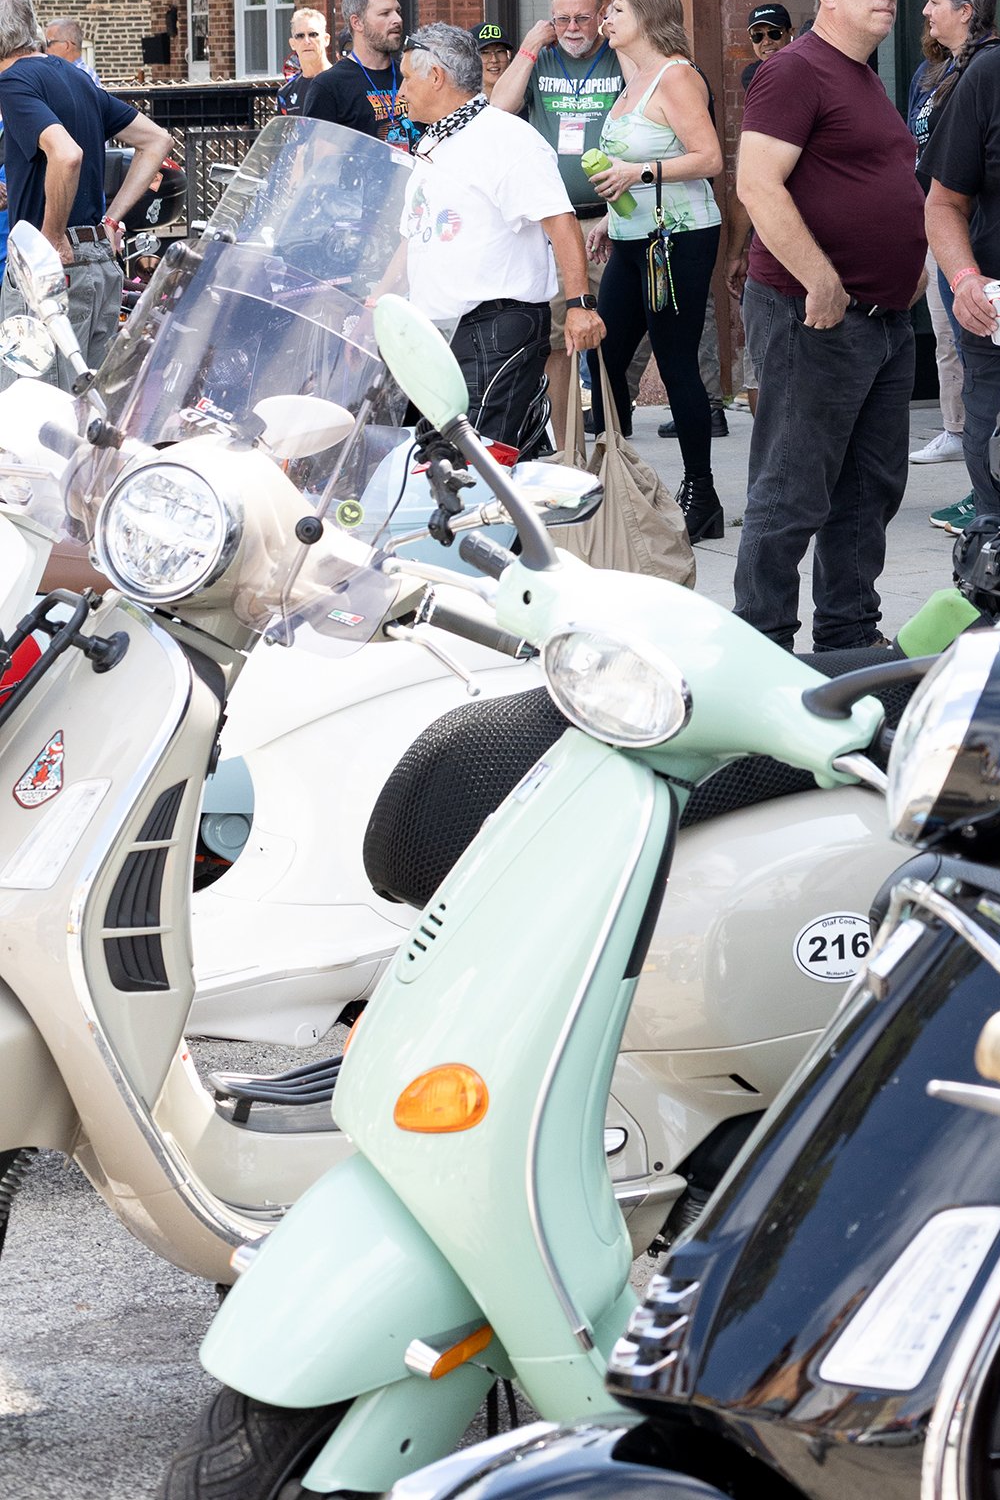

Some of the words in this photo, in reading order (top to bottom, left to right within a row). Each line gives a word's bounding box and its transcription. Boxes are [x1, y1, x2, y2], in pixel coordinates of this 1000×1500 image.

[479, 24, 502, 39] 40
[822, 919, 837, 928] Olaf
[839, 918, 857, 926] Cook
[808, 932, 870, 963] 216
